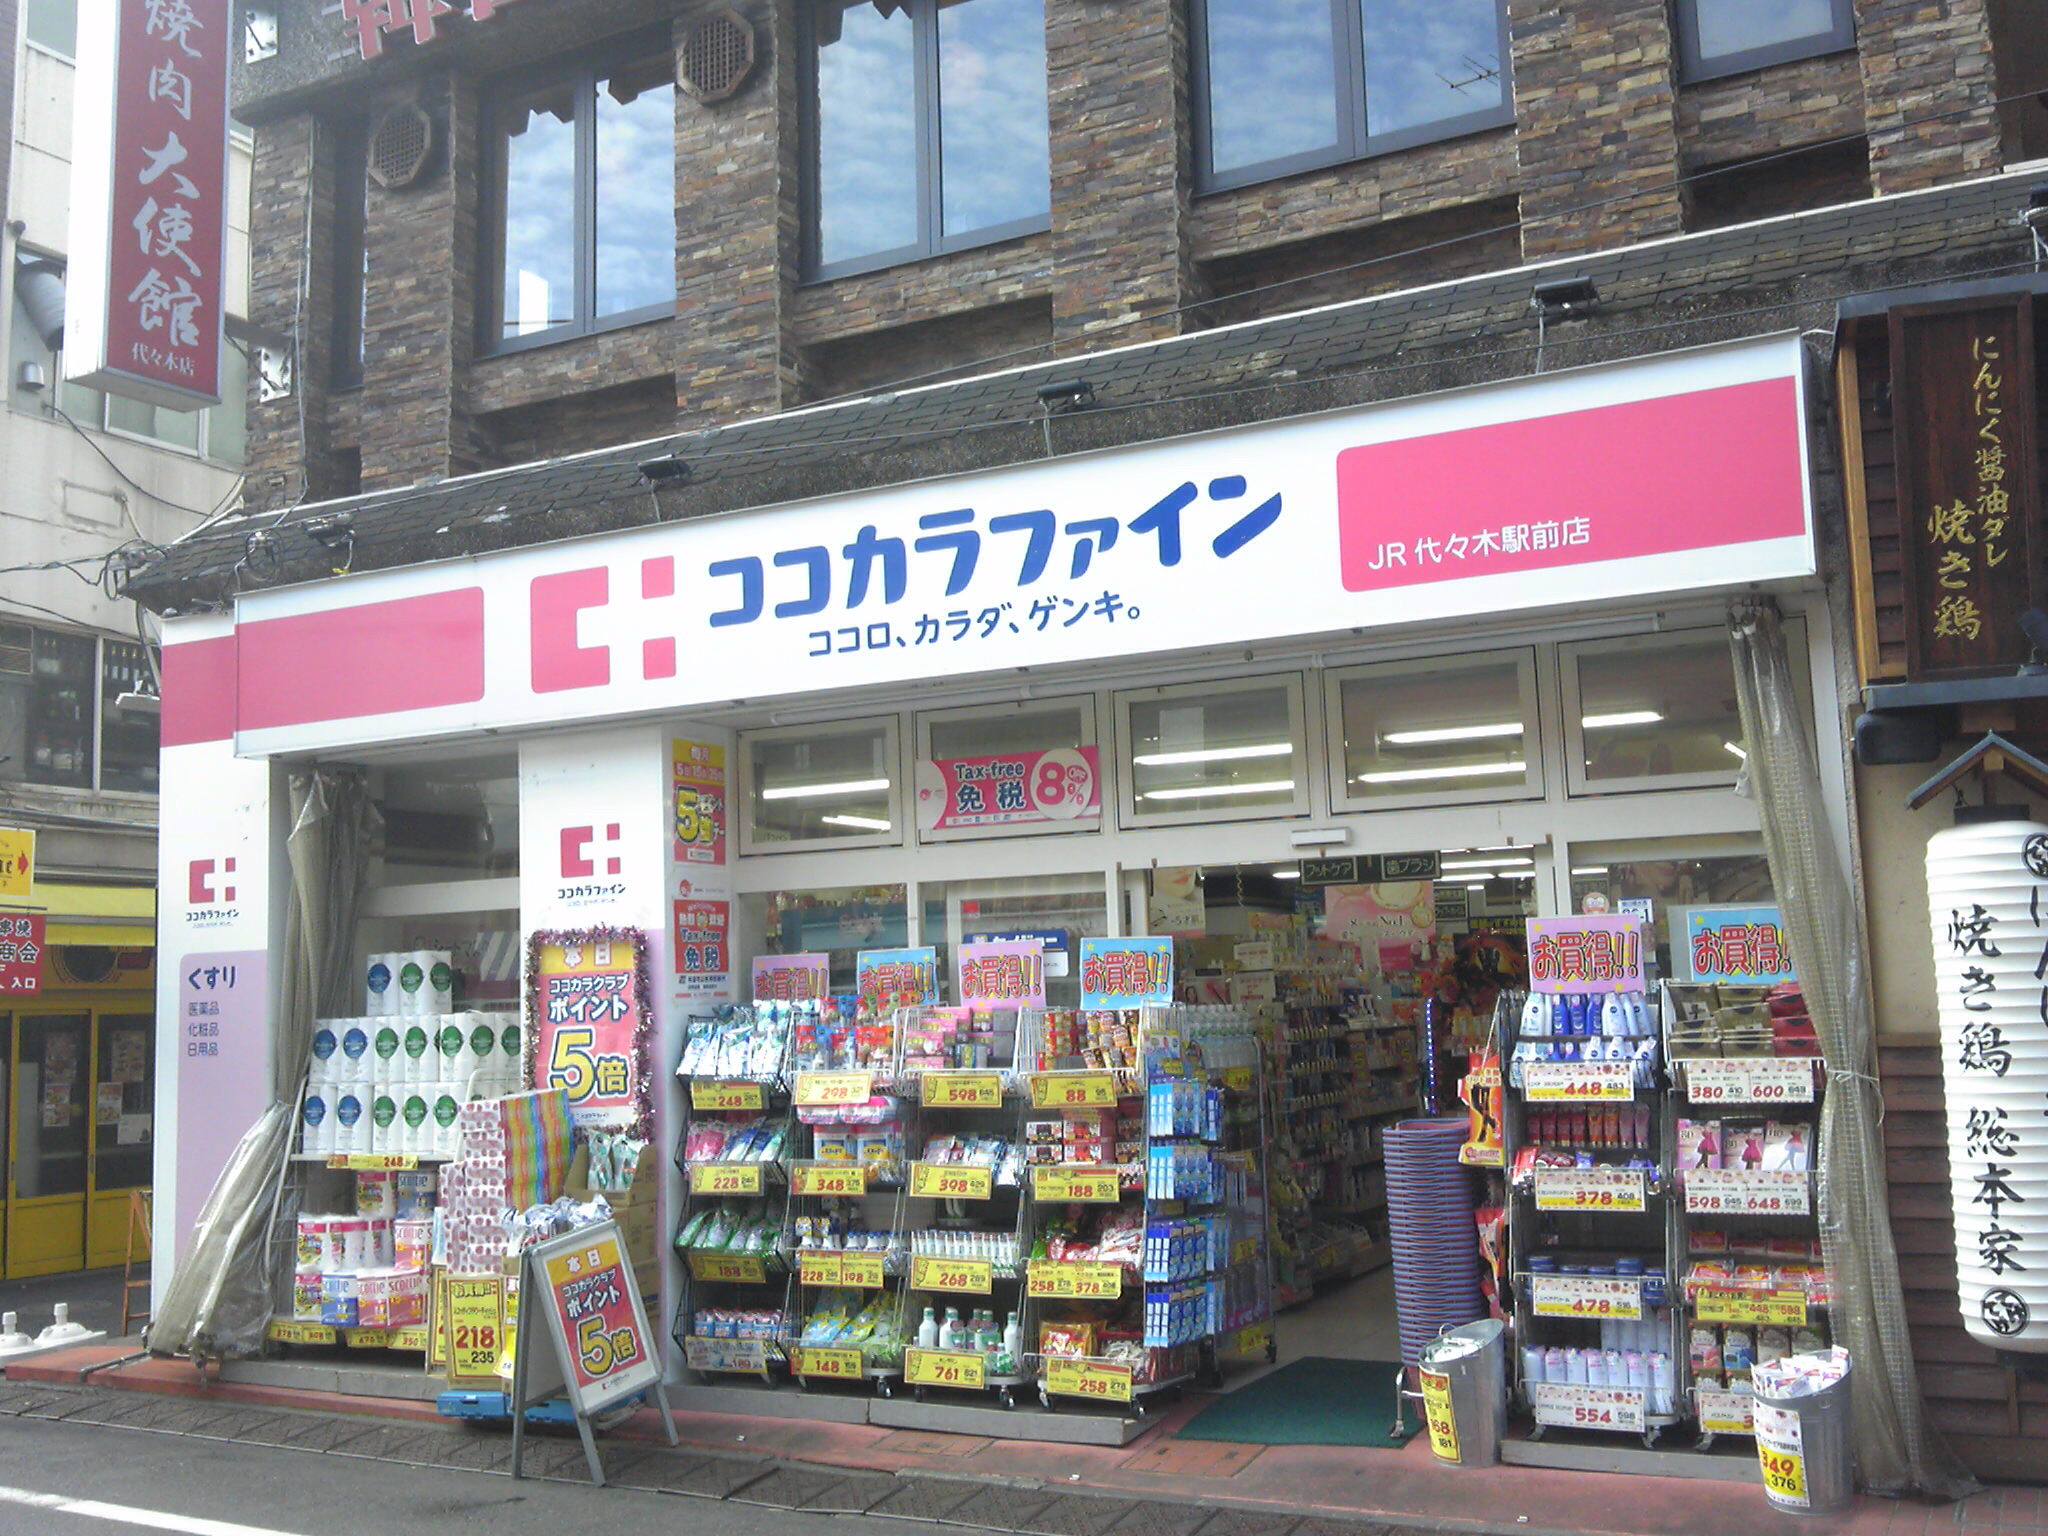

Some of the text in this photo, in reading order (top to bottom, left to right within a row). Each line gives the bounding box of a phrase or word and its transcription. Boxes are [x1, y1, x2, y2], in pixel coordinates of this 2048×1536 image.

[131, 342, 195, 376] 代々木店
[709, 475, 1282, 627] ココカラファイン
[1928, 500, 1981, 640] 焼き鶏
[809, 590, 1139, 656] ココロ、カラダ、ゲンキ。
[957, 779, 1026, 812] 免税
[558, 884, 626, 899] ココカラファイン
[186, 909, 240, 922] ココカラファイン
[11, 977, 36, 989] 入口
[189, 966, 236, 989] くすり
[550, 974, 630, 993] ココカラクラブ
[189, 1001, 220, 1016] 医薬品
[548, 994, 629, 1023] ポイント
[188, 1022, 219, 1037] 化粧品
[188, 1042, 219, 1057] 日用品
[949, 1089, 977, 1101] 598
[1066, 1090, 1086, 1102] 88
[1565, 1082, 1602, 1096] 448
[1692, 1086, 1723, 1098] 380
[1752, 1085, 1784, 1098] 600
[1948, 903, 2027, 1276] 焼き鶏 総本家
[718, 1096, 742, 1107] 248
[383, 1157, 403, 1168] 248
[713, 1177, 739, 1189] 228
[817, 1179, 845, 1191] 348
[1068, 1185, 1093, 1198] 188
[1575, 1191, 1613, 1205] 378
[1689, 1196, 1721, 1209] 598
[1748, 1197, 1781, 1209] 648
[803, 1271, 824, 1282] 228
[939, 1273, 968, 1287] 268
[1030, 1280, 1055, 1292] 258
[1075, 1282, 1100, 1294] 378
[566, 1284, 622, 1319] ポイント
[1572, 1299, 1611, 1314] 478
[456, 1325, 495, 1349] 218
[576, 1313, 637, 1378] 5倍
[471, 1350, 494, 1363] 235
[816, 1360, 840, 1374] 148
[935, 1366, 959, 1381] 761
[1078, 1378, 1107, 1393] 258
[1575, 1407, 1612, 1424] 554
[1771, 1474, 1796, 1491] 376
